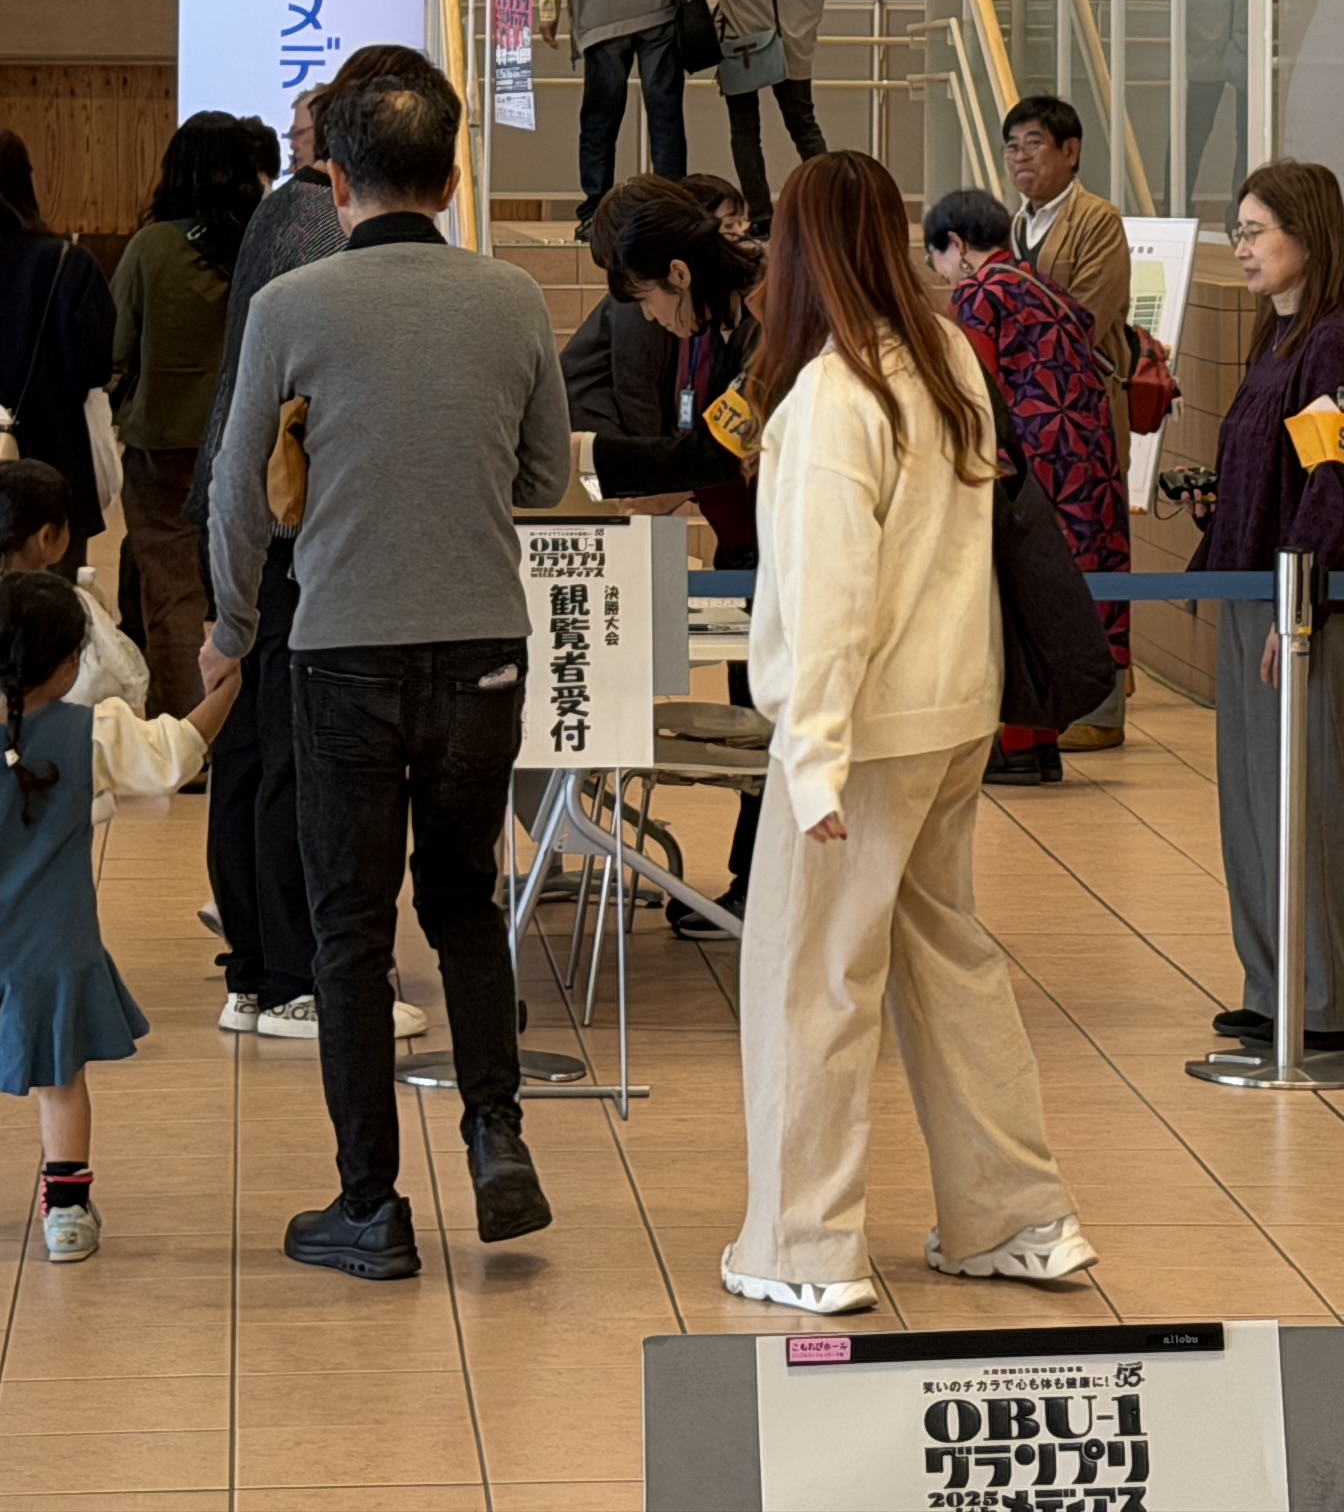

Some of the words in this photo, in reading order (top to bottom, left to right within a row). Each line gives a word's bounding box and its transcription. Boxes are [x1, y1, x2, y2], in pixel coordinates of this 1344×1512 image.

[712, 399, 752, 436] STA
[530, 537, 604, 552] OBU-1
[529, 552, 606, 567] グランプリ
[604, 585, 620, 646] 決勝大会
[549, 583, 591, 753] 観覧者受付
[791, 1341, 849, 1352] こもれびホール
[1163, 1334, 1199, 1345] allobu
[922, 1376, 1110, 1395] 笑いのチカラで心も体も健康に!
[924, 1394, 1149, 1443] OBU-1
[924, 1438, 1150, 1489] グランプリ
[927, 1490, 1000, 1508] 2025
